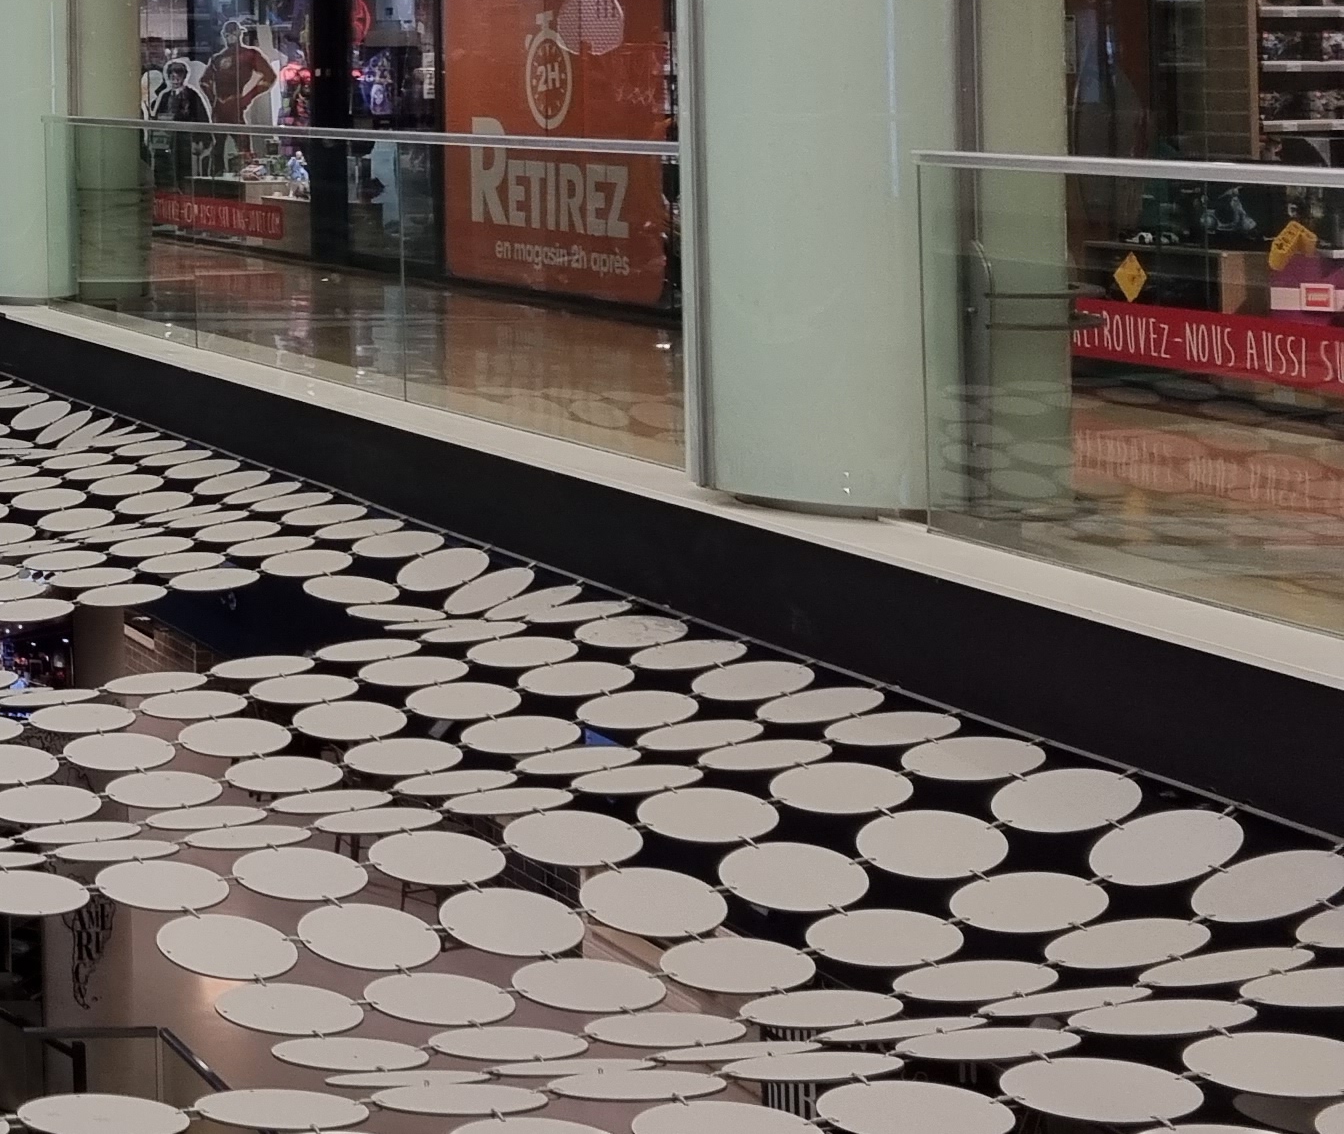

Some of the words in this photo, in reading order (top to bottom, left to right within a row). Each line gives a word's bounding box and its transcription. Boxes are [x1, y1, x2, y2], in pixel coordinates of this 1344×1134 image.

[536, 62, 561, 93] 2H
[470, 116, 630, 239] RETIREZ
[495, 241, 511, 259] en
[513, 242, 568, 270] magasin
[591, 247, 630, 276] après
[1246, 330, 1307, 379] AUSSI
